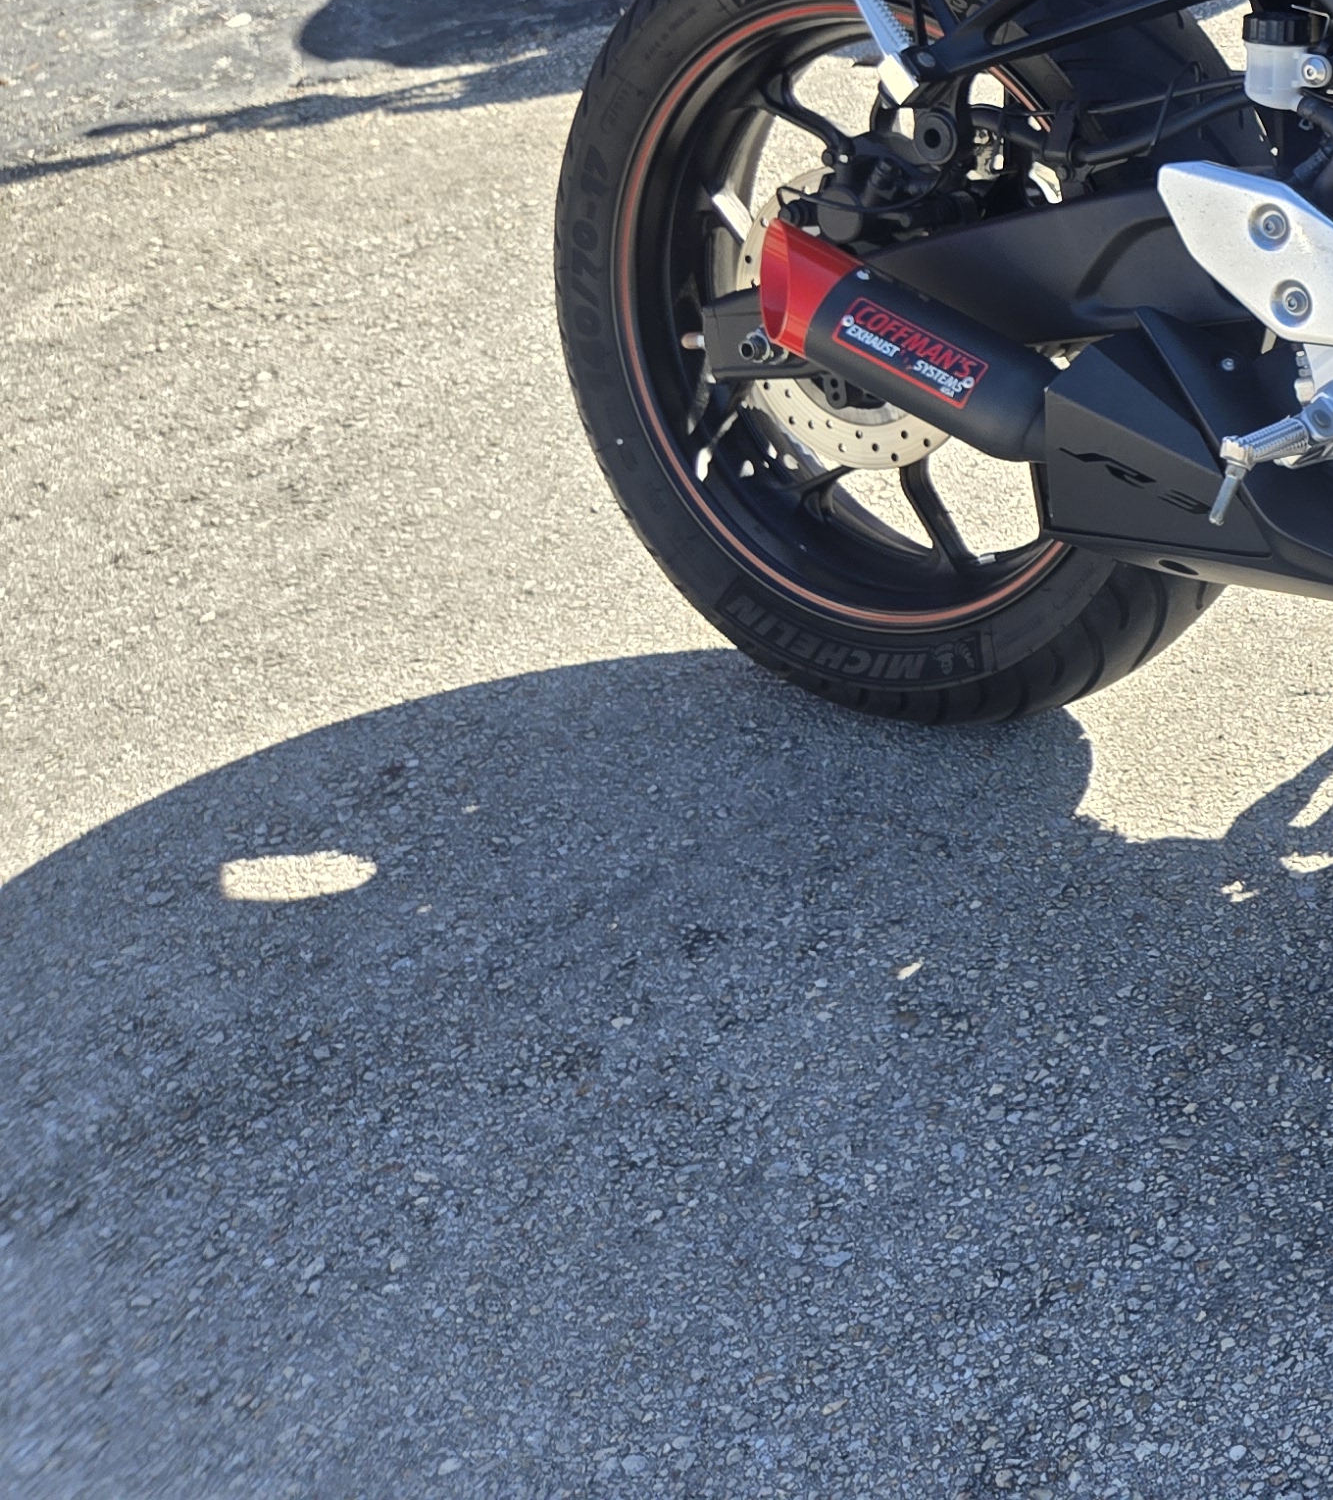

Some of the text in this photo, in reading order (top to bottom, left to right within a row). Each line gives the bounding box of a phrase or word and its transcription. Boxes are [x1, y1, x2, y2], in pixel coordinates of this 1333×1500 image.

[845, 324, 965, 393] EXHAUST SYSTEMS
[853, 306, 978, 378] COFFMAN'S
[726, 594, 927, 680] MICHELIN
